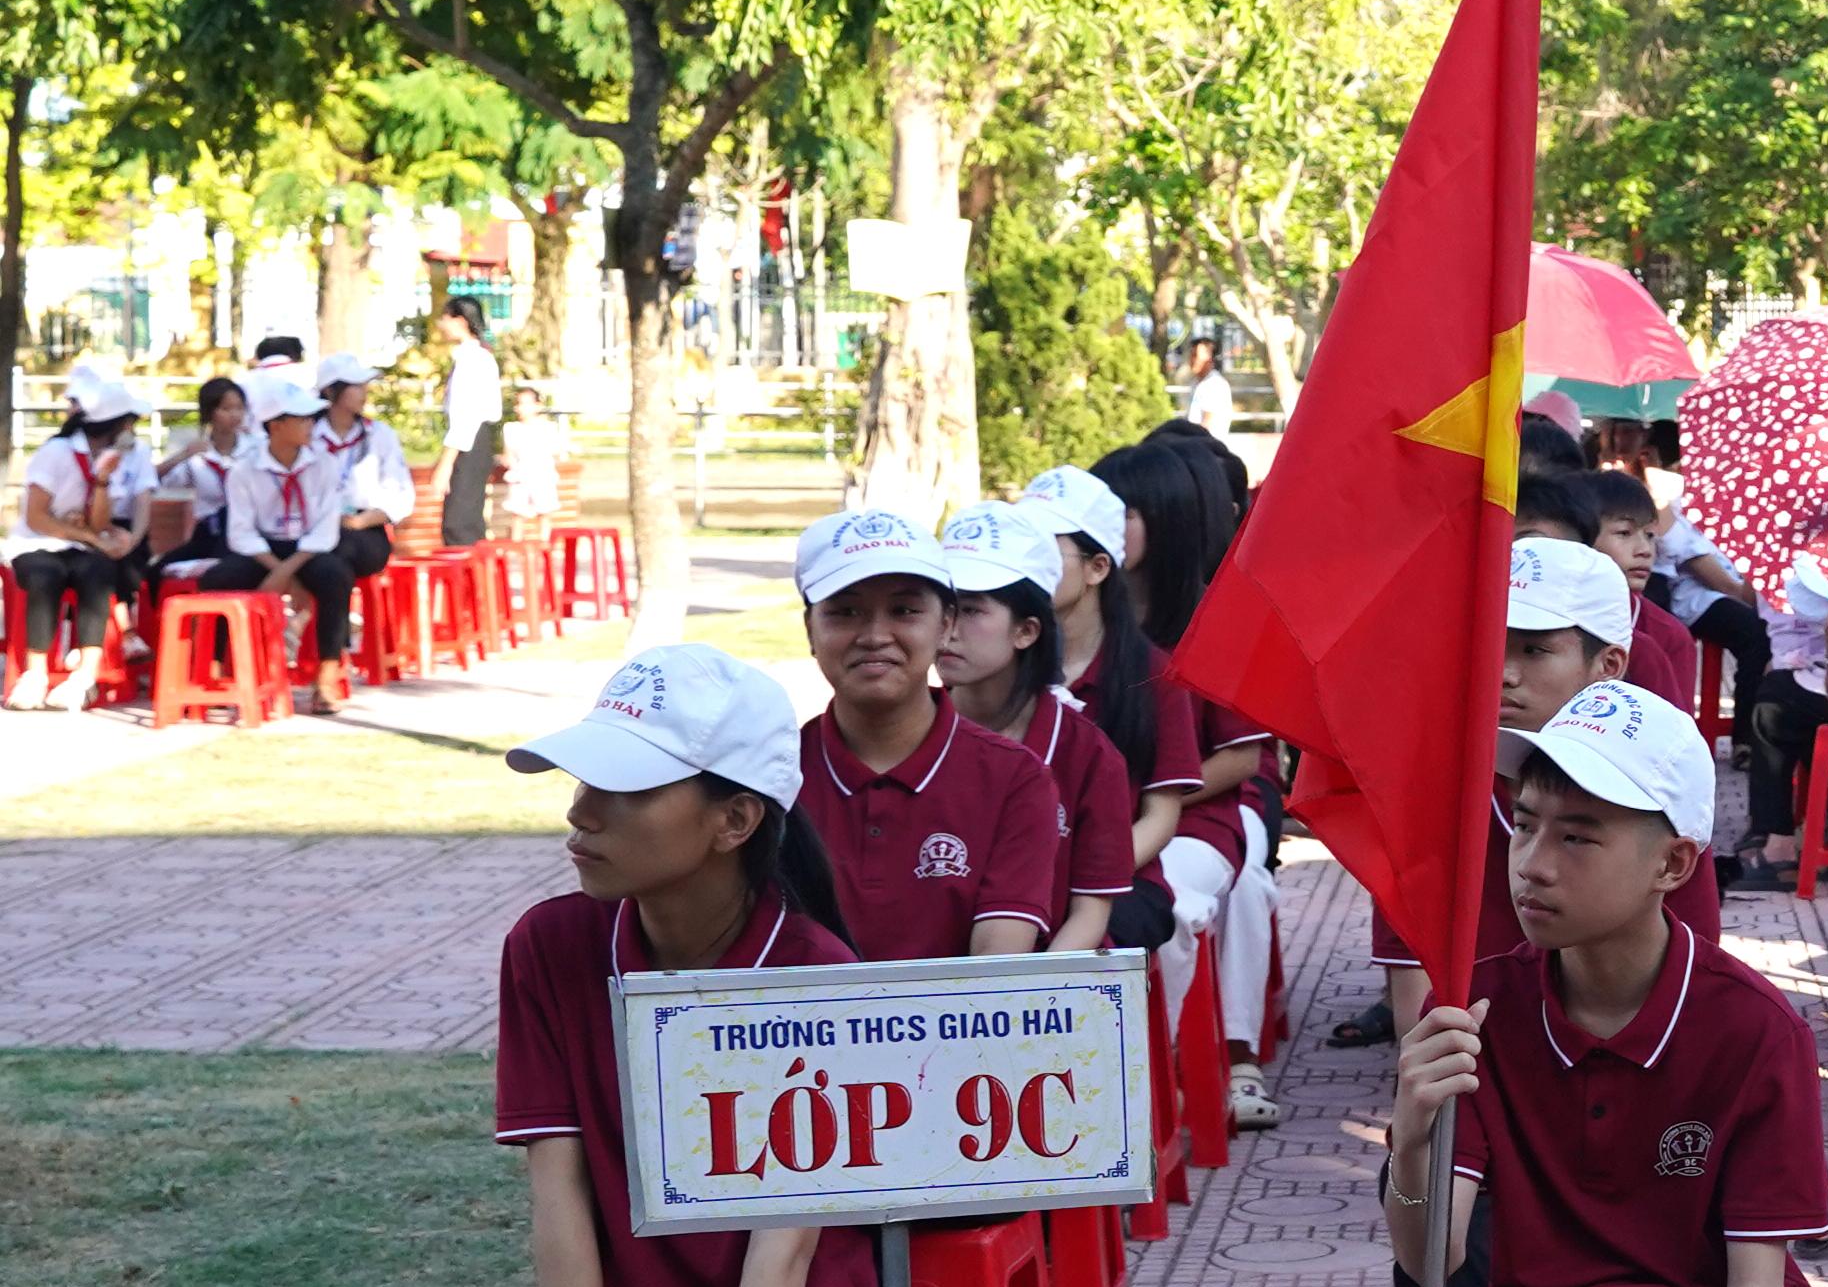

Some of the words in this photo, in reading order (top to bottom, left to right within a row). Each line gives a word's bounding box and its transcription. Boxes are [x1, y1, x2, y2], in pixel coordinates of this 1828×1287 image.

[708, 1014, 837, 1053] TRƯỜNG
[846, 1015, 928, 1046] THCS
[938, 1011, 1012, 1042] GIAO
[1022, 995, 1075, 1037] HẢI
[700, 1056, 913, 1182] LỚP
[954, 1068, 1081, 1163] 9C
